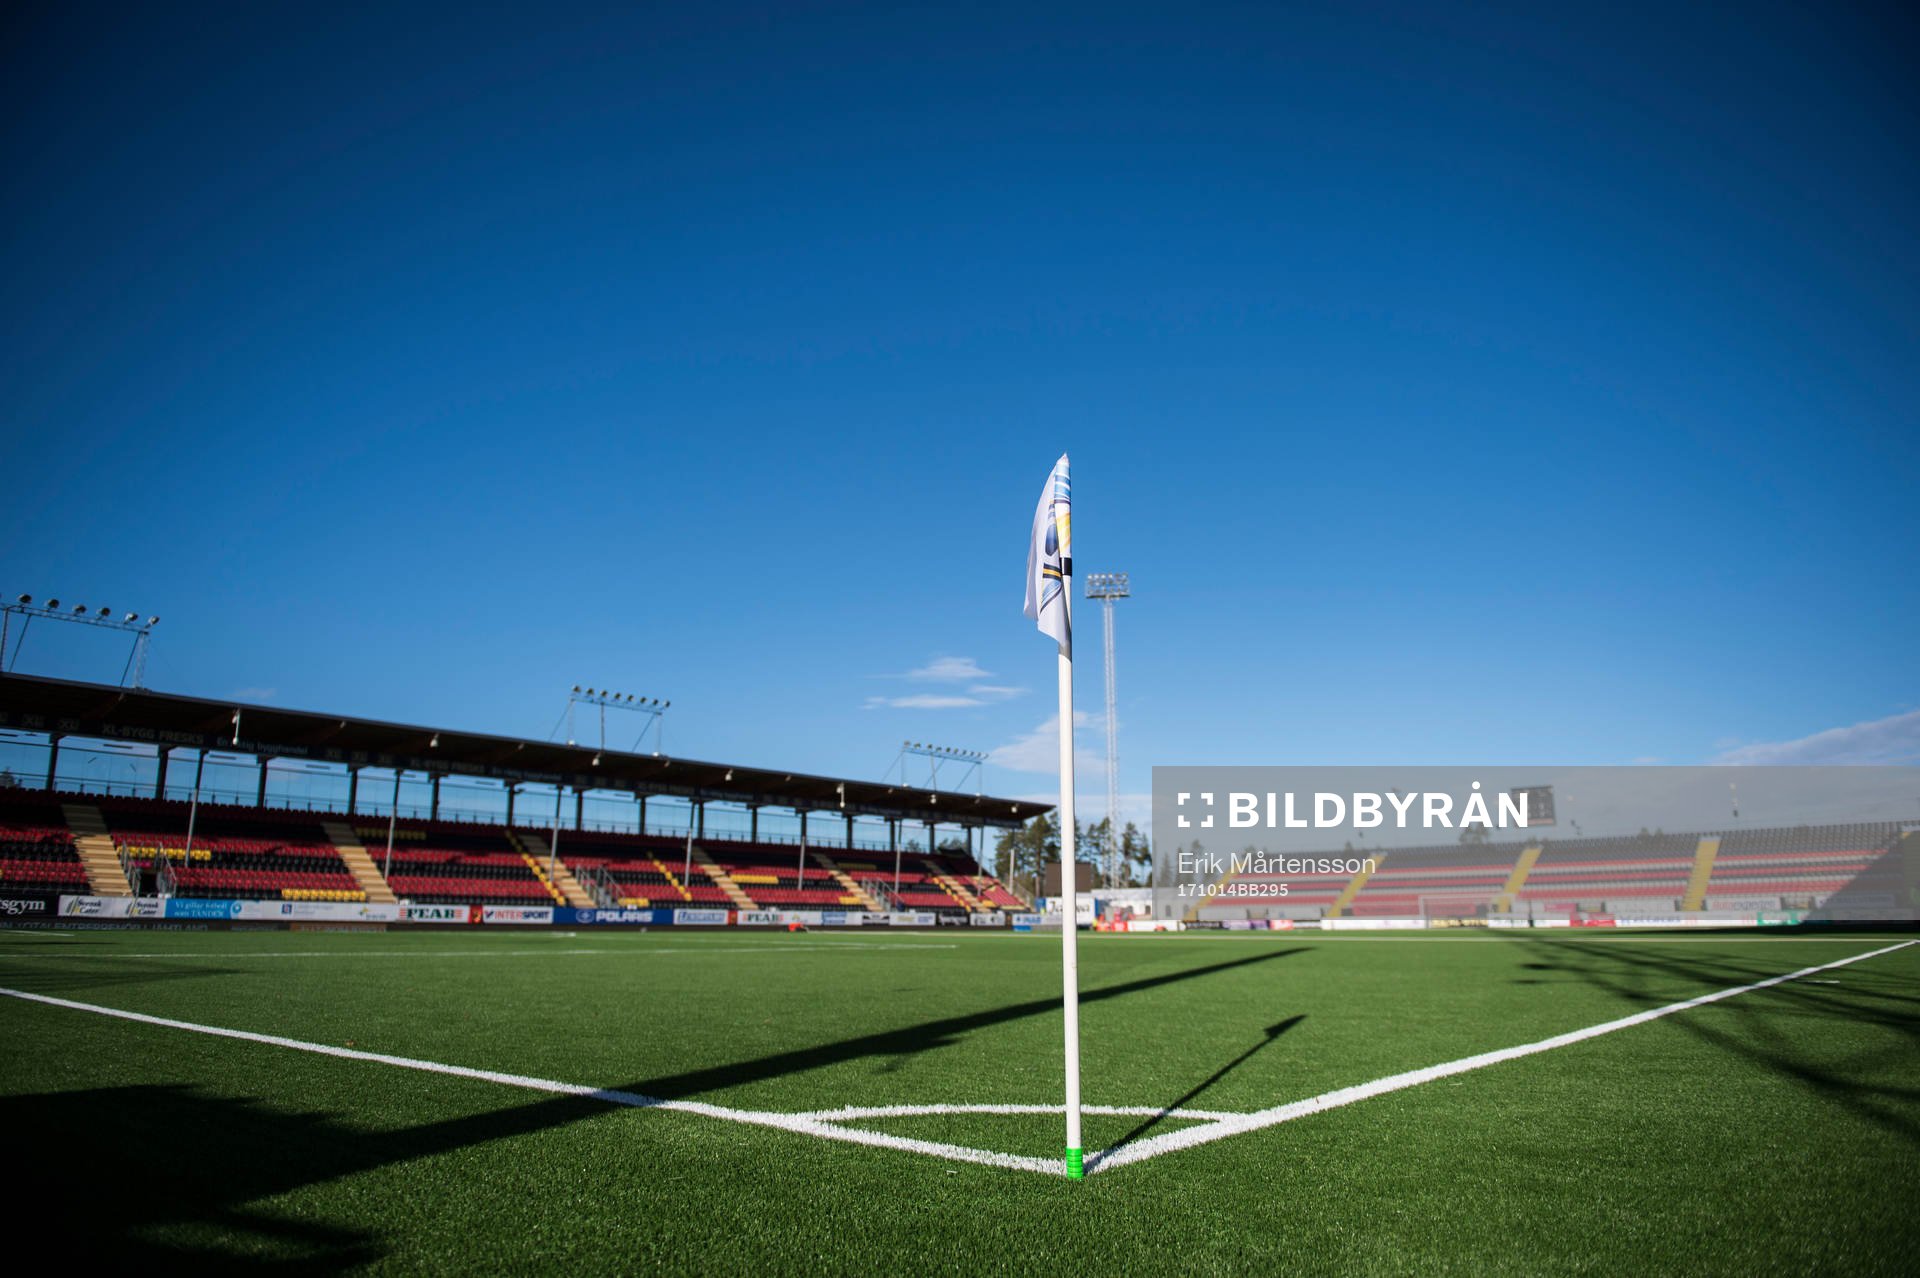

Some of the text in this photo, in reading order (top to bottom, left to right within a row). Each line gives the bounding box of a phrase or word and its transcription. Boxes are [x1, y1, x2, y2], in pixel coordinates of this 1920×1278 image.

[0, 900, 46, 914] sgym
[407, 908, 456, 919] PEAB
[494, 910, 549, 920] INTERSPORT
[596, 910, 653, 922] POLARIS
